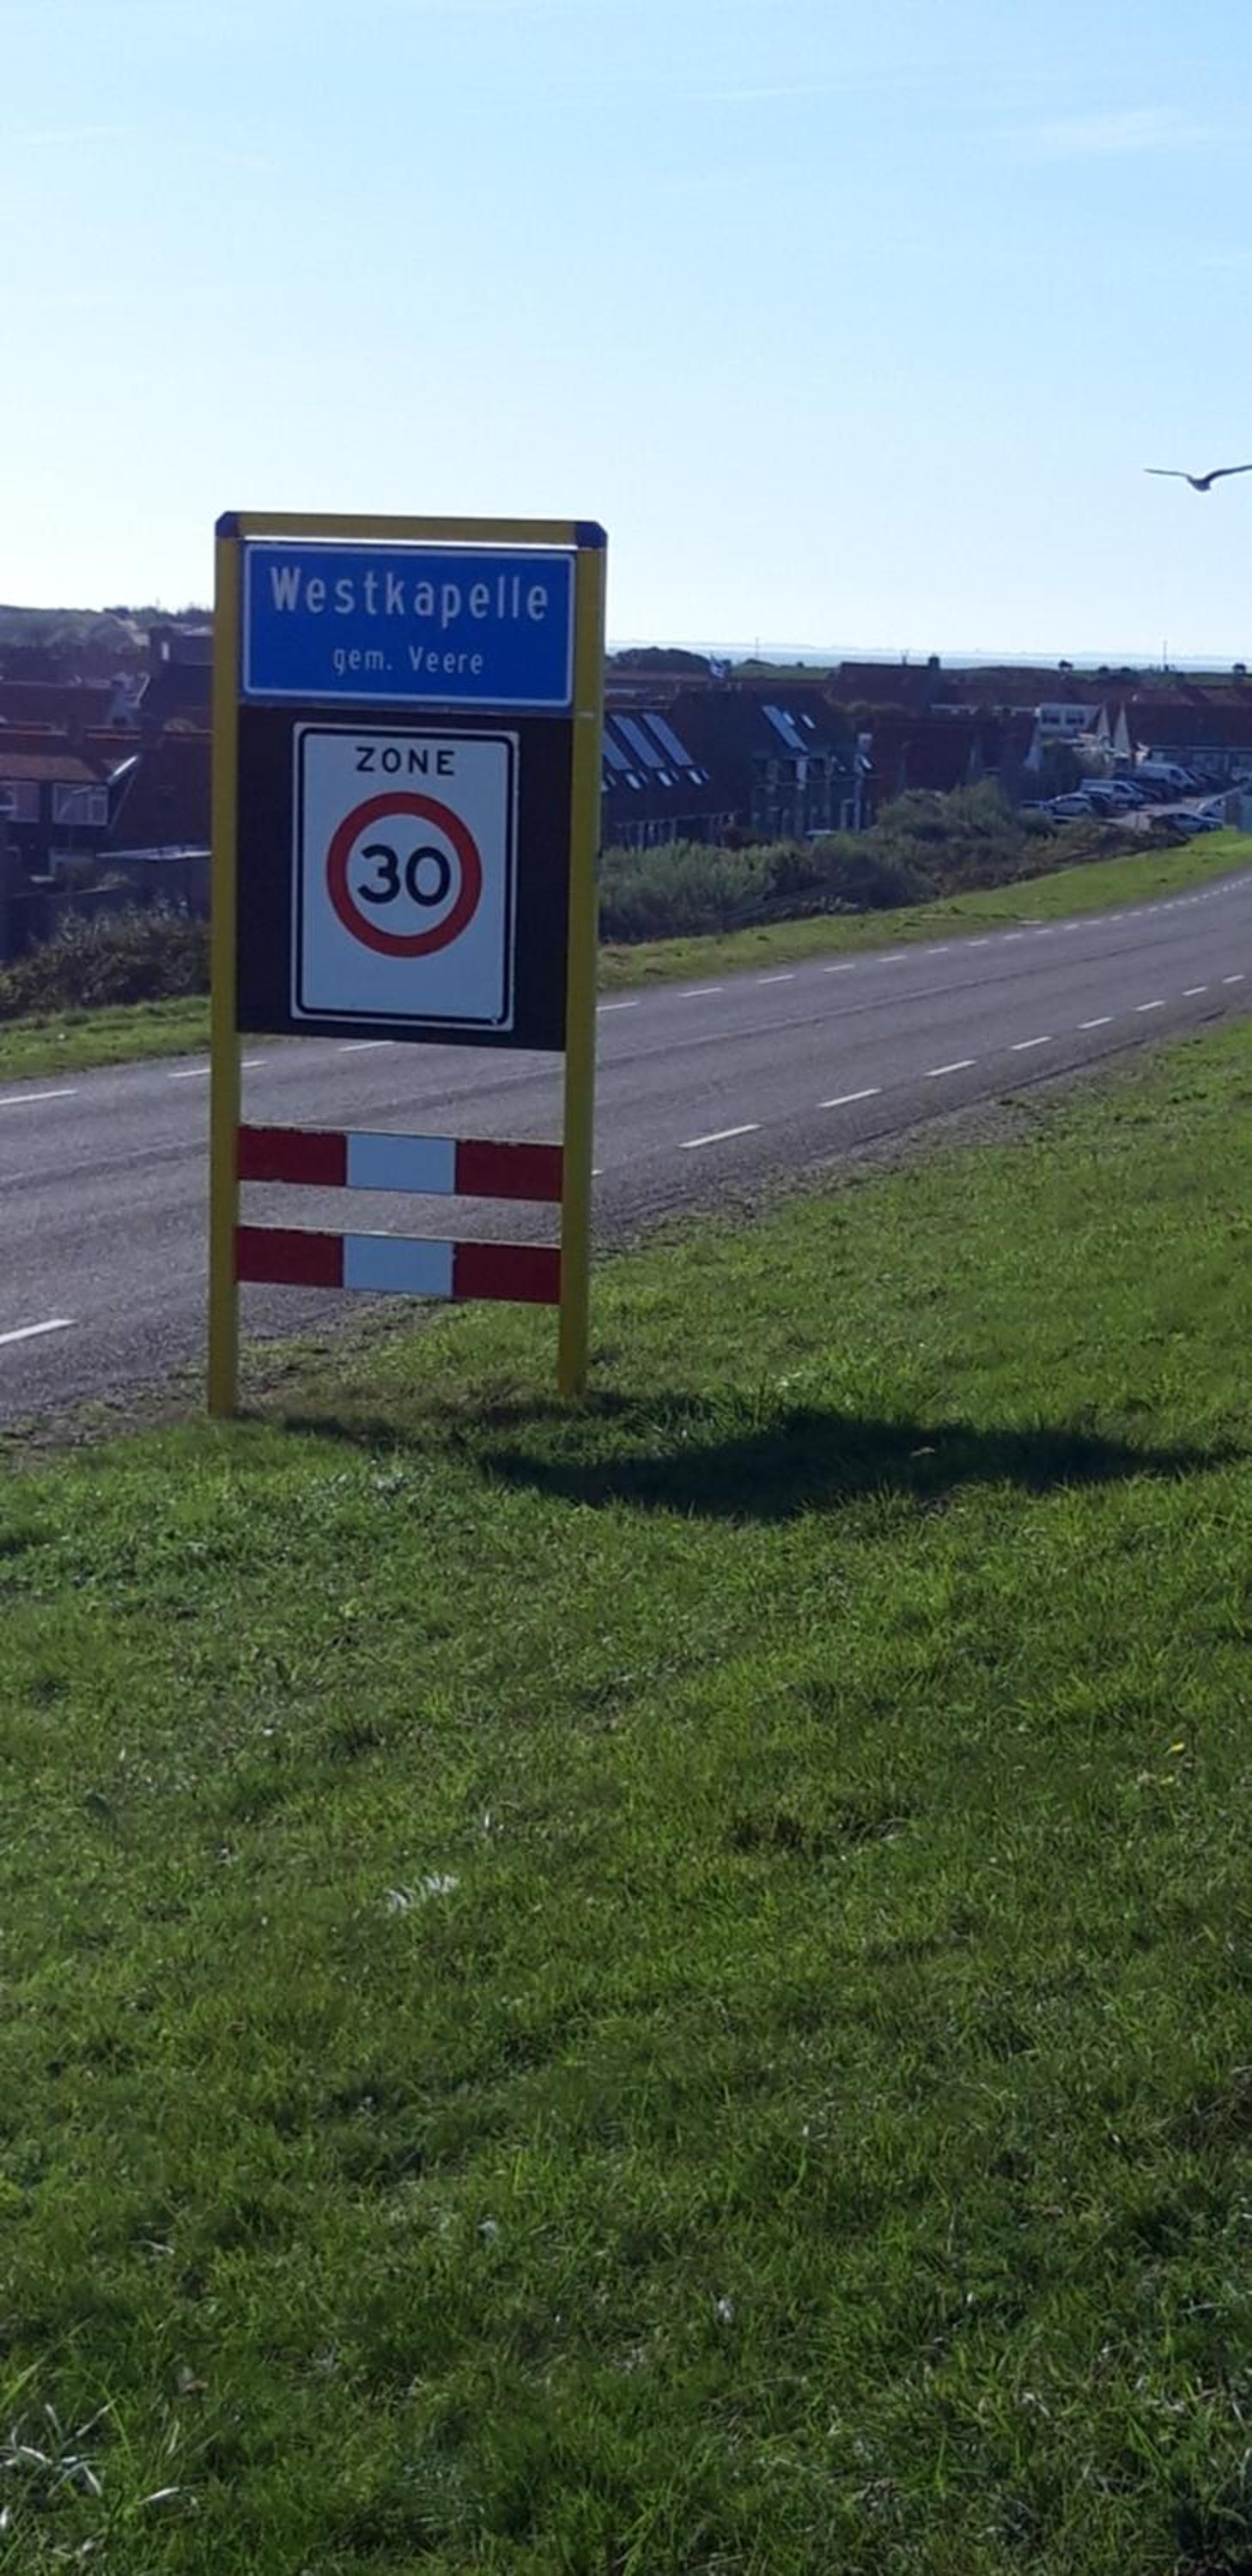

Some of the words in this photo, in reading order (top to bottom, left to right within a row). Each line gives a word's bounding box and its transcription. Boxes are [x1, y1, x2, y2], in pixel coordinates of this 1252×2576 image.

[270, 566, 550, 629] Westkapelle
[332, 648, 393, 676] gem.
[408, 646, 484, 675] Veere
[356, 746, 456, 776] ZONE
[356, 843, 452, 908] 30
